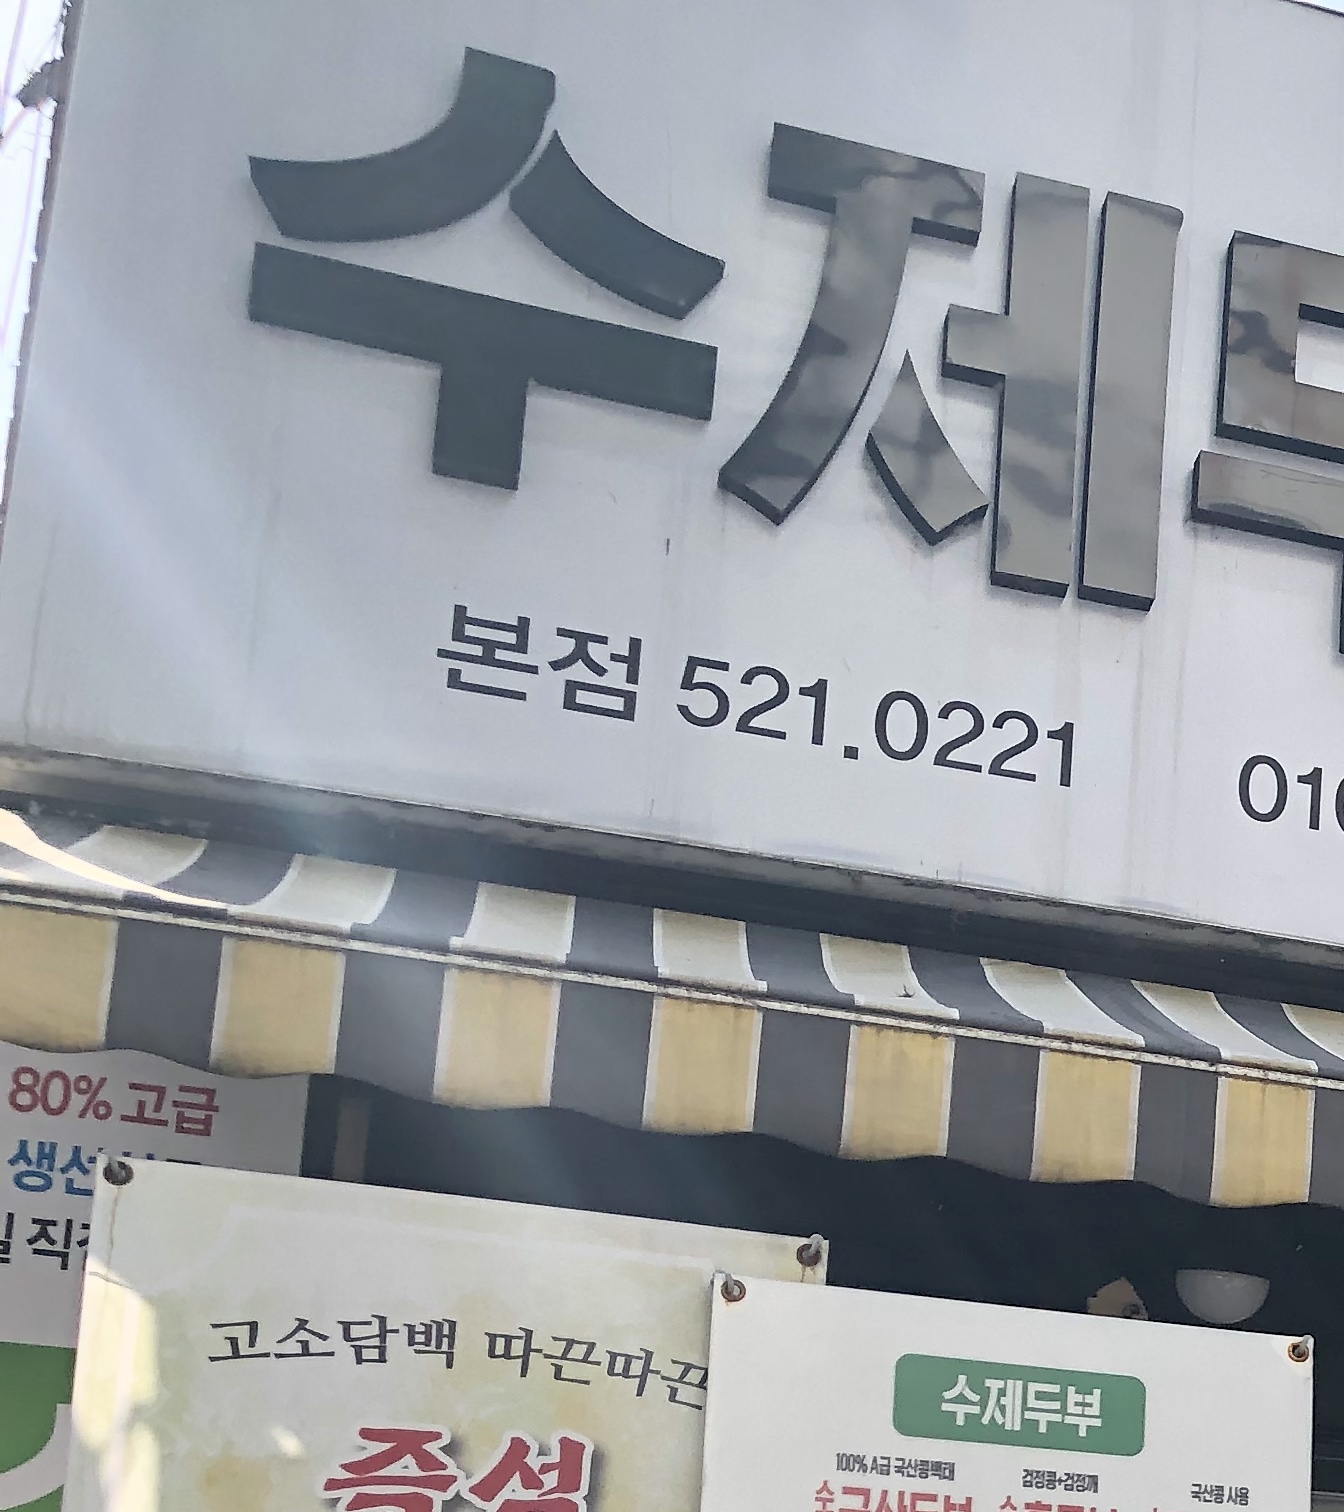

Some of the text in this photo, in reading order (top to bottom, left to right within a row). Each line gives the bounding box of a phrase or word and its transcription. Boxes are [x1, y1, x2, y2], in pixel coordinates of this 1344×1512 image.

[435, 603, 1076, 790] 본점 521.0221
[8, 1066, 219, 1137] 80% 고급
[208, 1314, 708, 1411] 고소담백 따끈따끈
[941, 1374, 1103, 1437] 수제두부
[836, 1452, 867, 1474] 100%
[869, 1456, 890, 1477] A급
[1191, 1482, 1250, 1506] 국산콩 사용
